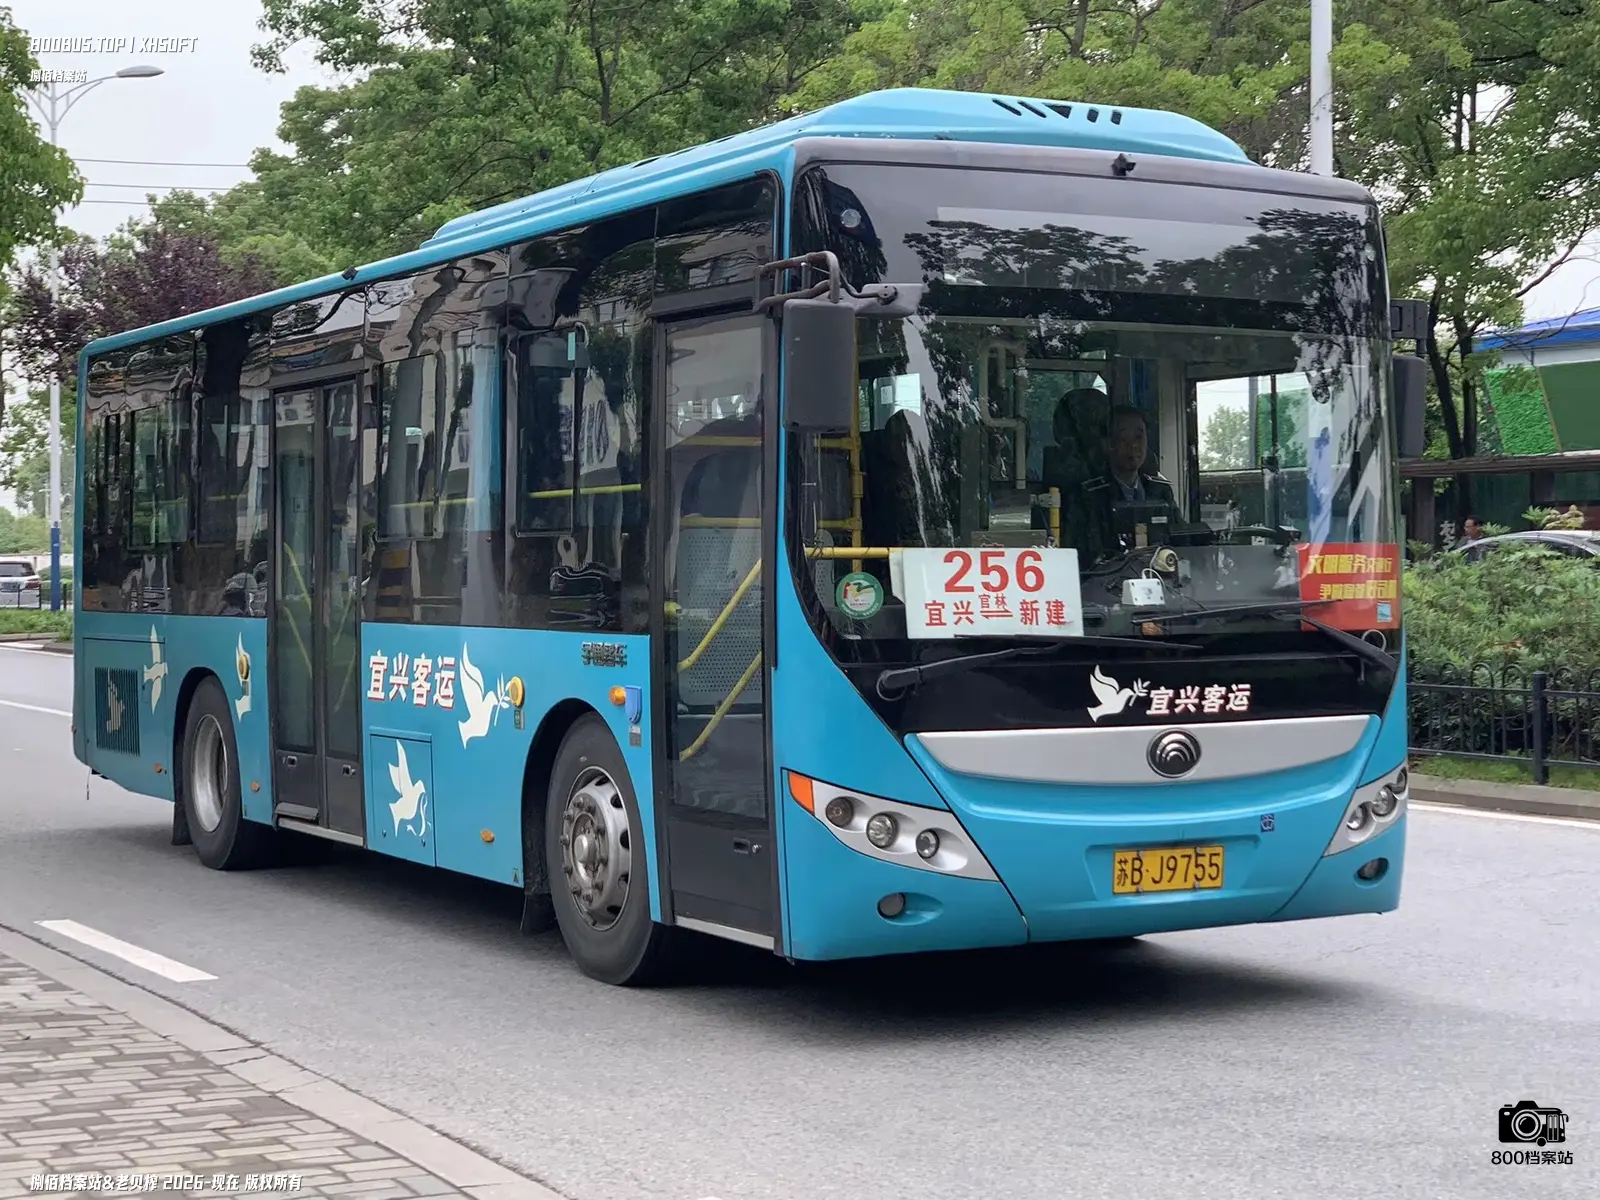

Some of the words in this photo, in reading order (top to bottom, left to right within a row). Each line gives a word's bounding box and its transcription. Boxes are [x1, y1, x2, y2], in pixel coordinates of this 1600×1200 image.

[943, 550, 1045, 593] 256
[924, 600, 974, 626] 宜兴
[1020, 599, 1067, 626] 新建
[978, 593, 1008, 609] 官林
[367, 650, 456, 710] 宜兴客运
[1146, 684, 1251, 716] 宜兴客运
